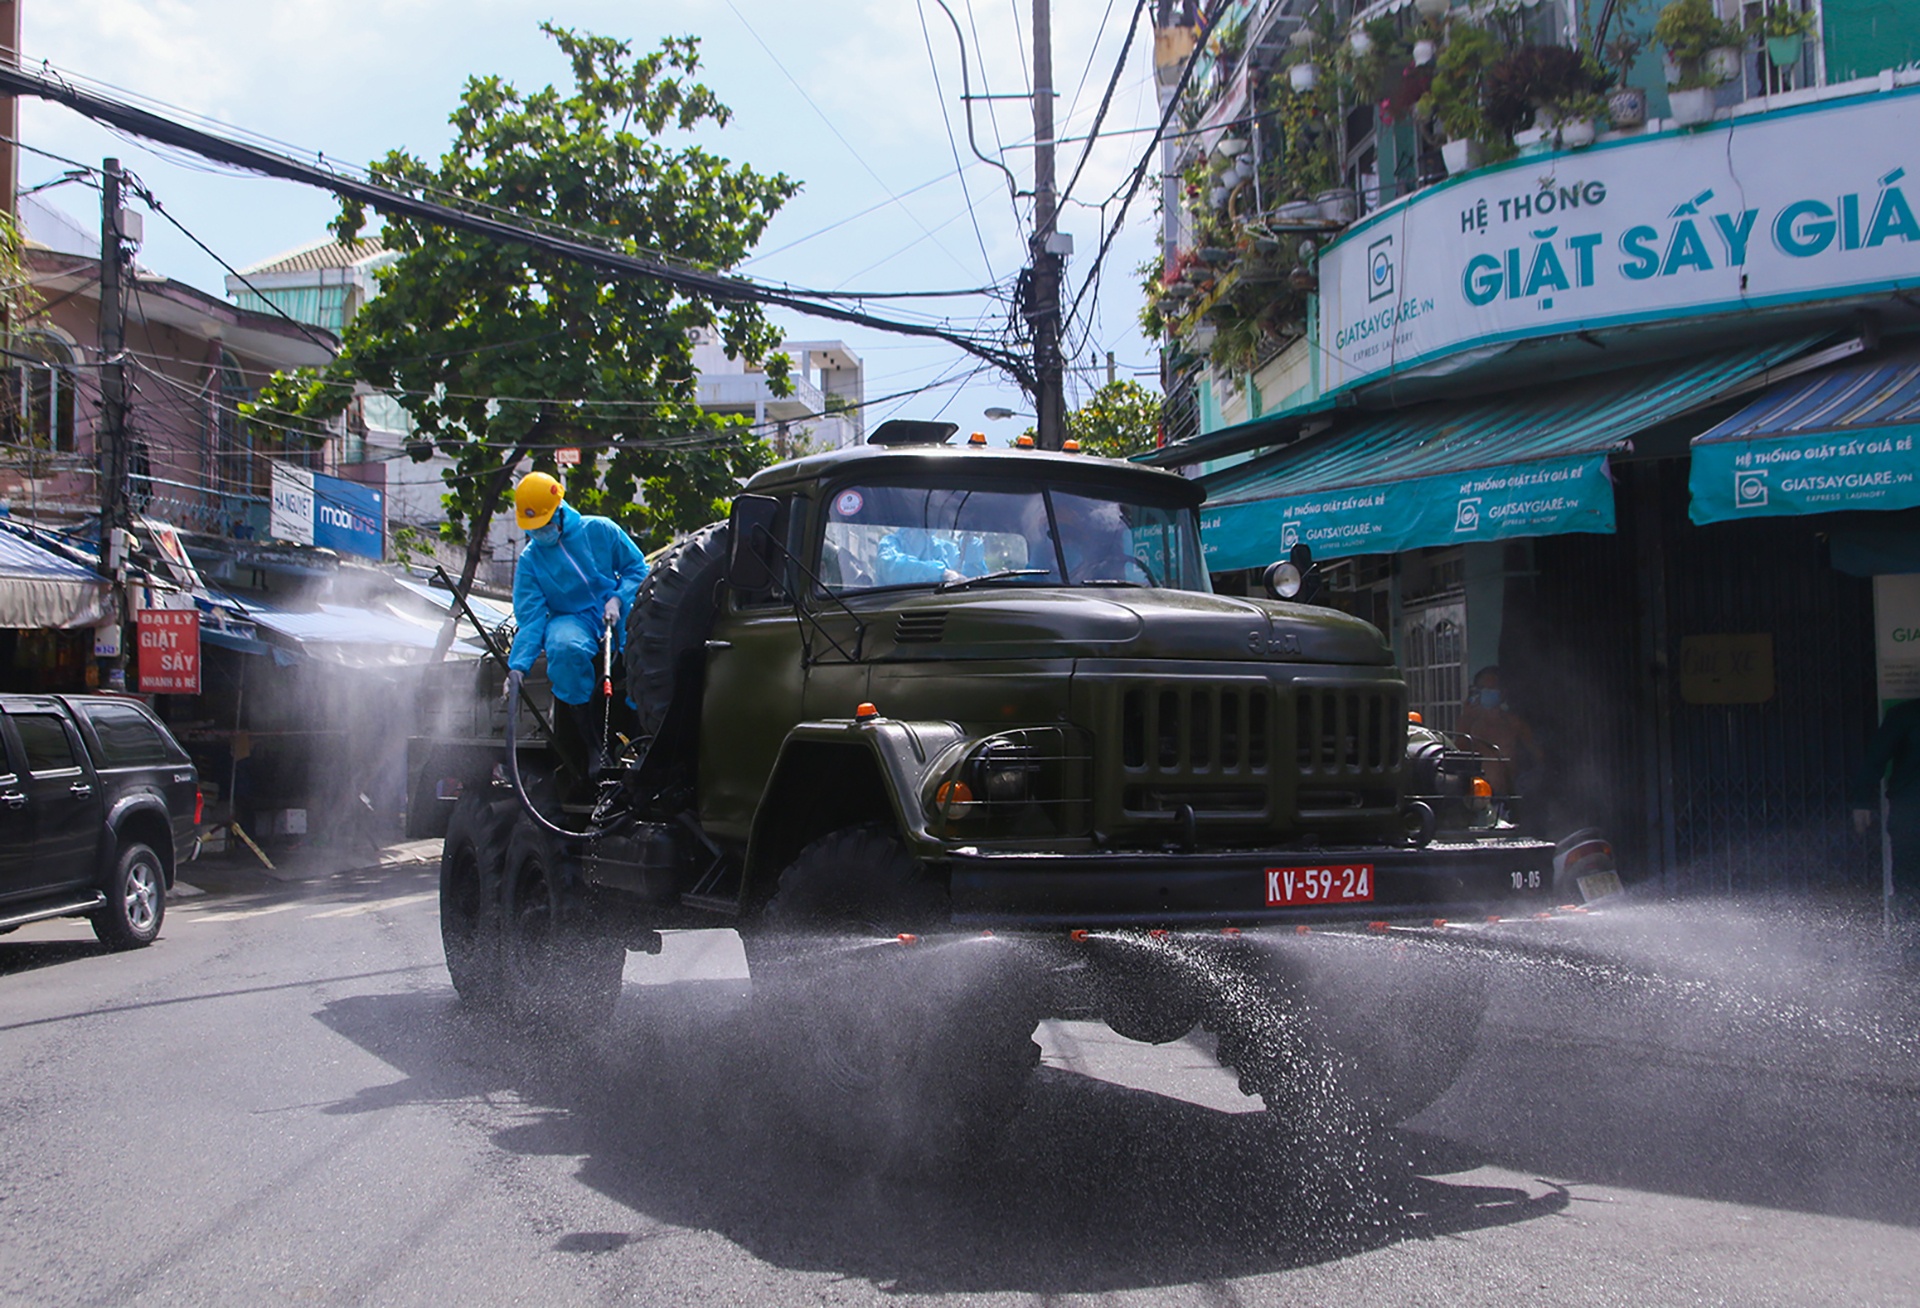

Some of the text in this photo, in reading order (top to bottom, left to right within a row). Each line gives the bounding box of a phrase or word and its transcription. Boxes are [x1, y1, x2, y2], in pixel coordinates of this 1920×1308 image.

[1461, 178, 1607, 235] HỆ THỐNG
[1461, 167, 1920, 310] GIẶT SẤY GIÁ
[1336, 298, 1434, 350] GIATSAYGIARE.VN
[1735, 452, 1752, 467] HỆ
[1755, 448, 1801, 464] THỐNG
[1804, 444, 1837, 460] GIẶT
[1838, 440, 1865, 456] SẤY
[1867, 438, 1892, 454] GIÁ
[1474, 475, 1506, 492] THỐNG
[1531, 470, 1550, 484] SẤY
[1551, 468, 1568, 482] GIÁ
[1781, 471, 1913, 492] GIATSAYGIARE.VN
[1488, 497, 1578, 518] GIATSAYGIARE.VN
[1306, 522, 1382, 540] GIATSAYGIARE.VN
[141, 614, 169, 627] ĐẠI
[141, 628, 178, 651] GIẶT
[161, 649, 194, 671] SẤY
[142, 676, 173, 688] NHANH
[174, 677, 182, 688] &
[1268, 867, 1369, 902] KV-59-24
